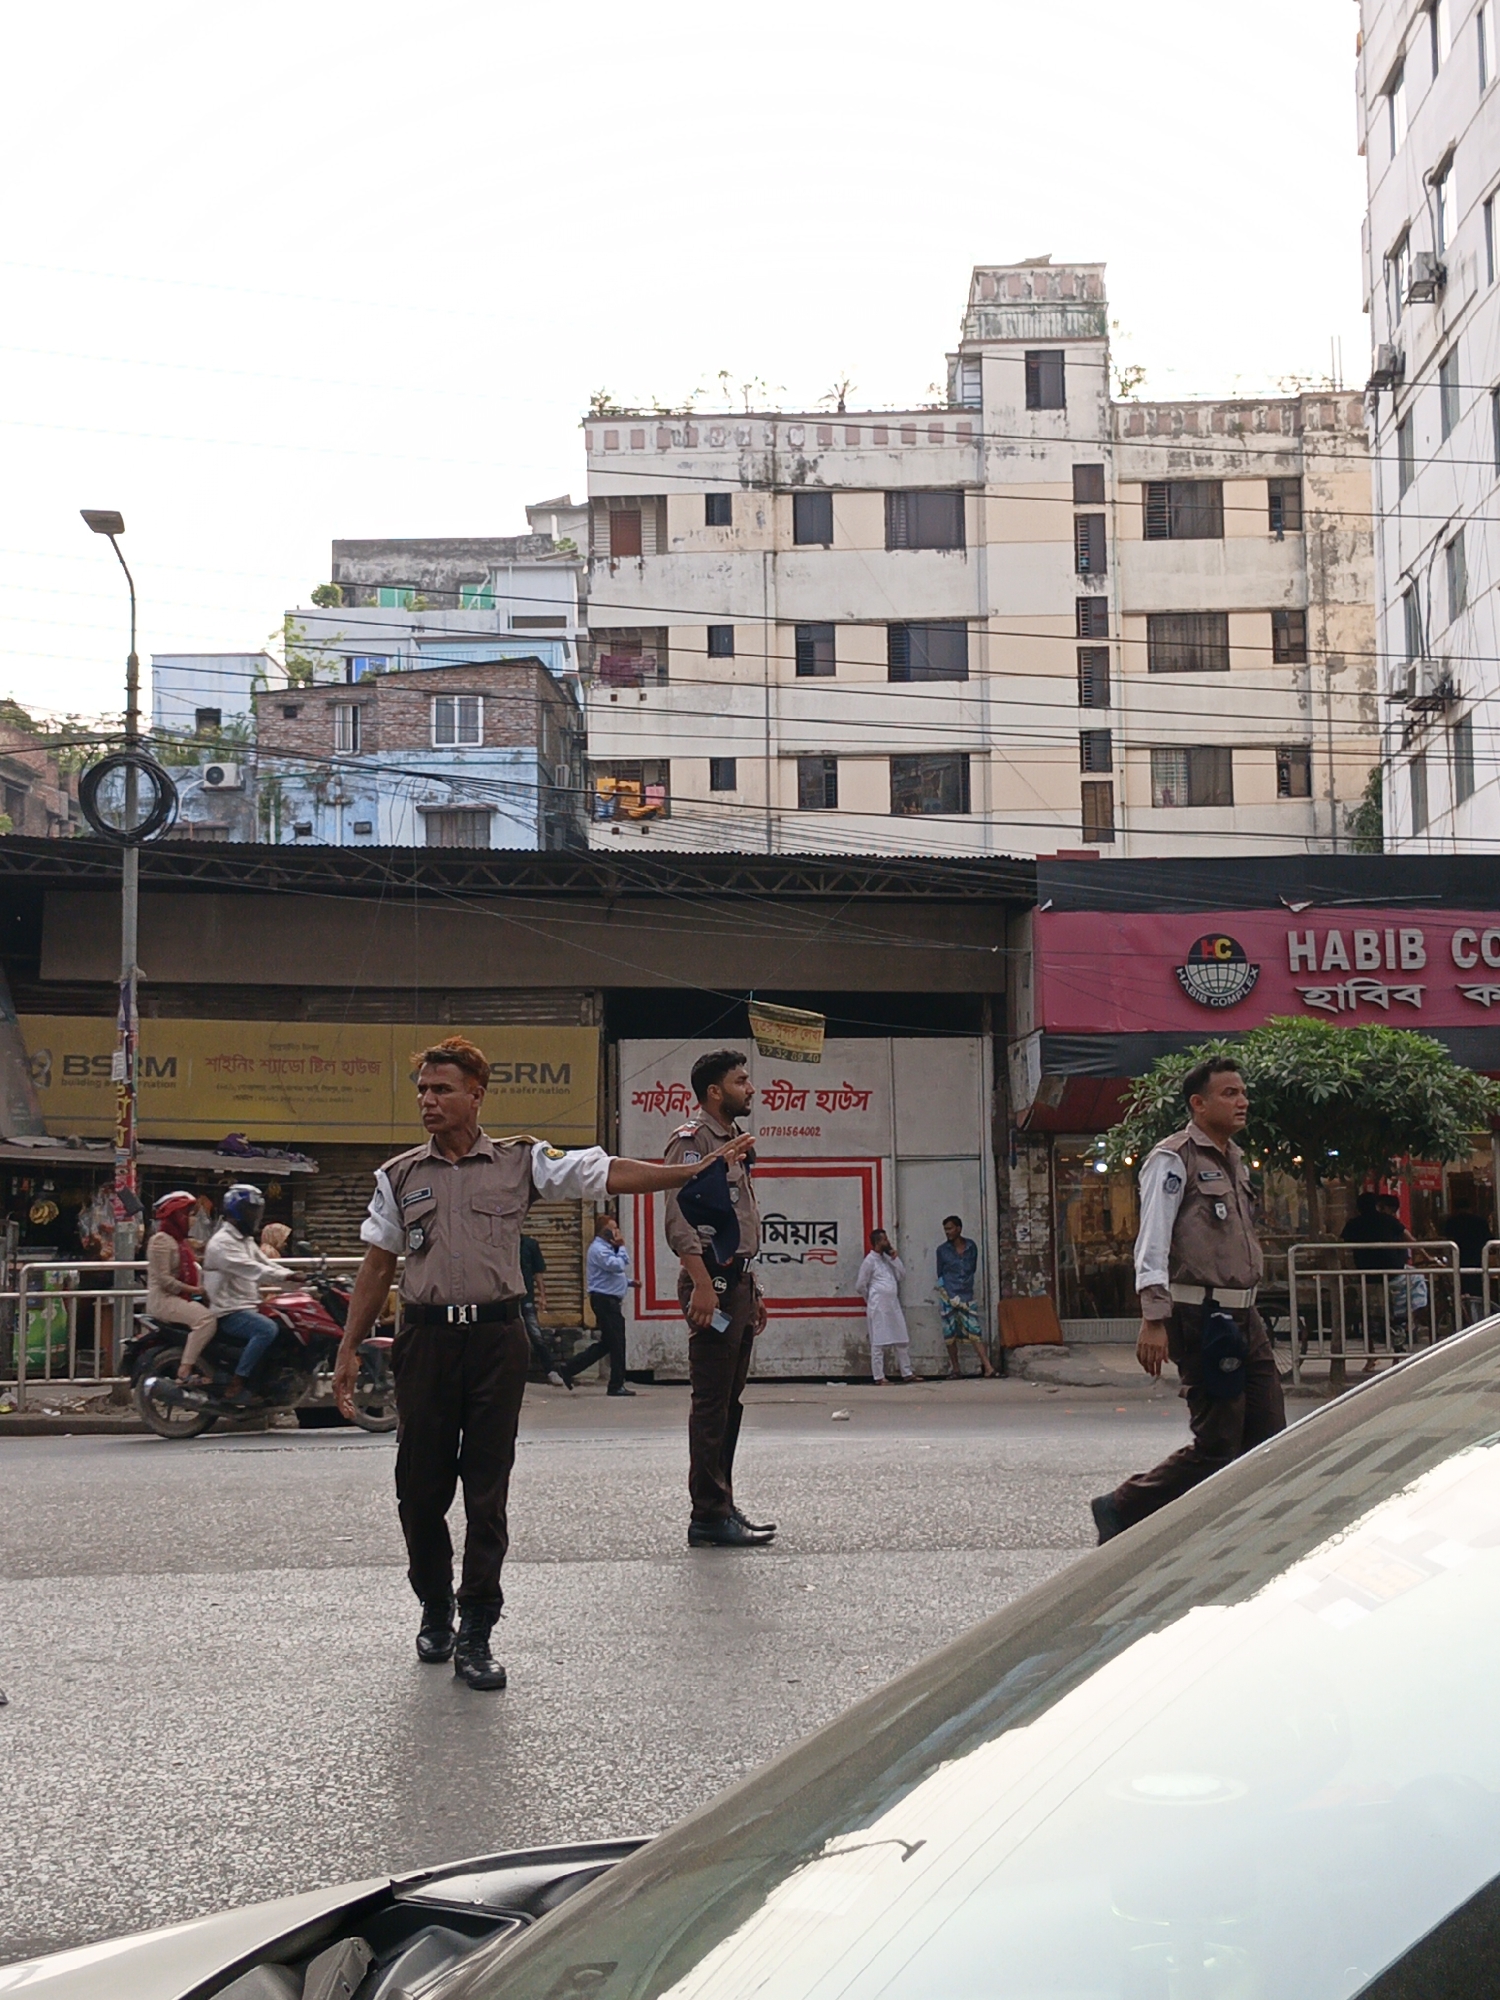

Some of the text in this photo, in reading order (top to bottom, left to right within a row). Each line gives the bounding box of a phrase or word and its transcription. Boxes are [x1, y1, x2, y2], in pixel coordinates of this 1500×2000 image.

[1201, 938, 1233, 961] HC
[1287, 928, 1427, 973] HABIB
[1176, 967, 1259, 1007] HABIB COMPLEX
[1295, 976, 1427, 1014] হাবিব
[63, 1054, 177, 1078] BSM
[205, 1053, 255, 1075] শাইনিং
[806, 1053, 819, 1063] 40
[61, 1078, 102, 1089] building
[144, 1080, 176, 1089] nation
[488, 1062, 571, 1085] SRM
[510, 1086, 537, 1094] safer
[538, 1086, 571, 1095] nation
[631, 1080, 692, 1118] শাইনিং
[814, 1081, 873, 1114] হাউস
